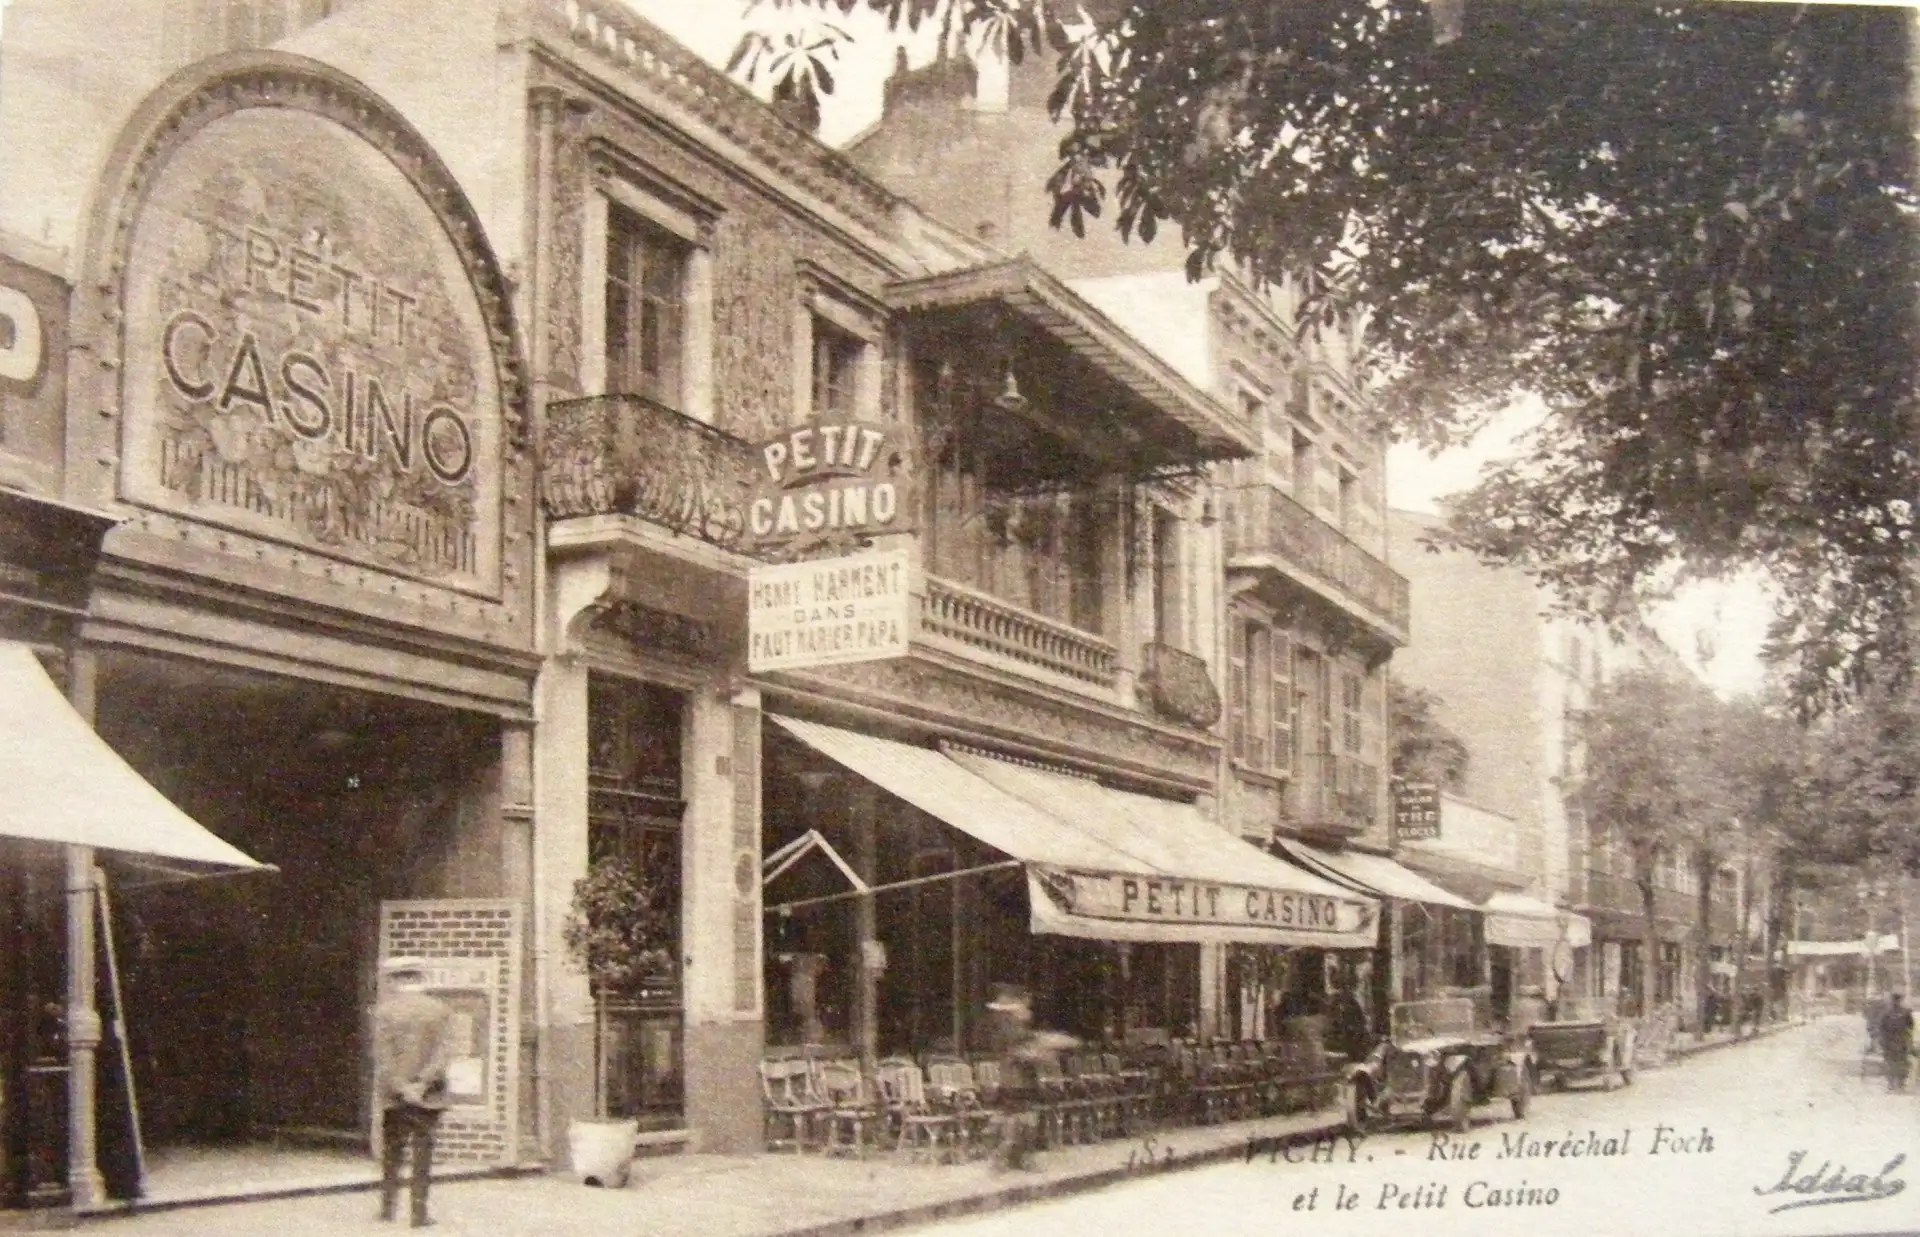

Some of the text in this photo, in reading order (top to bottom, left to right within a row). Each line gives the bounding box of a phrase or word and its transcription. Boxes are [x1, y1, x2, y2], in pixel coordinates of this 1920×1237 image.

[244, 225, 416, 347] PETIT
[163, 310, 472, 485] CASINO
[764, 425, 884, 482] PETIT
[751, 483, 896, 535] CASINO
[753, 629, 792, 660] FAUT
[857, 618, 900, 648] PAPA
[794, 604, 855, 625] DANS
[1121, 878, 1338, 926] PETIT CASINO
